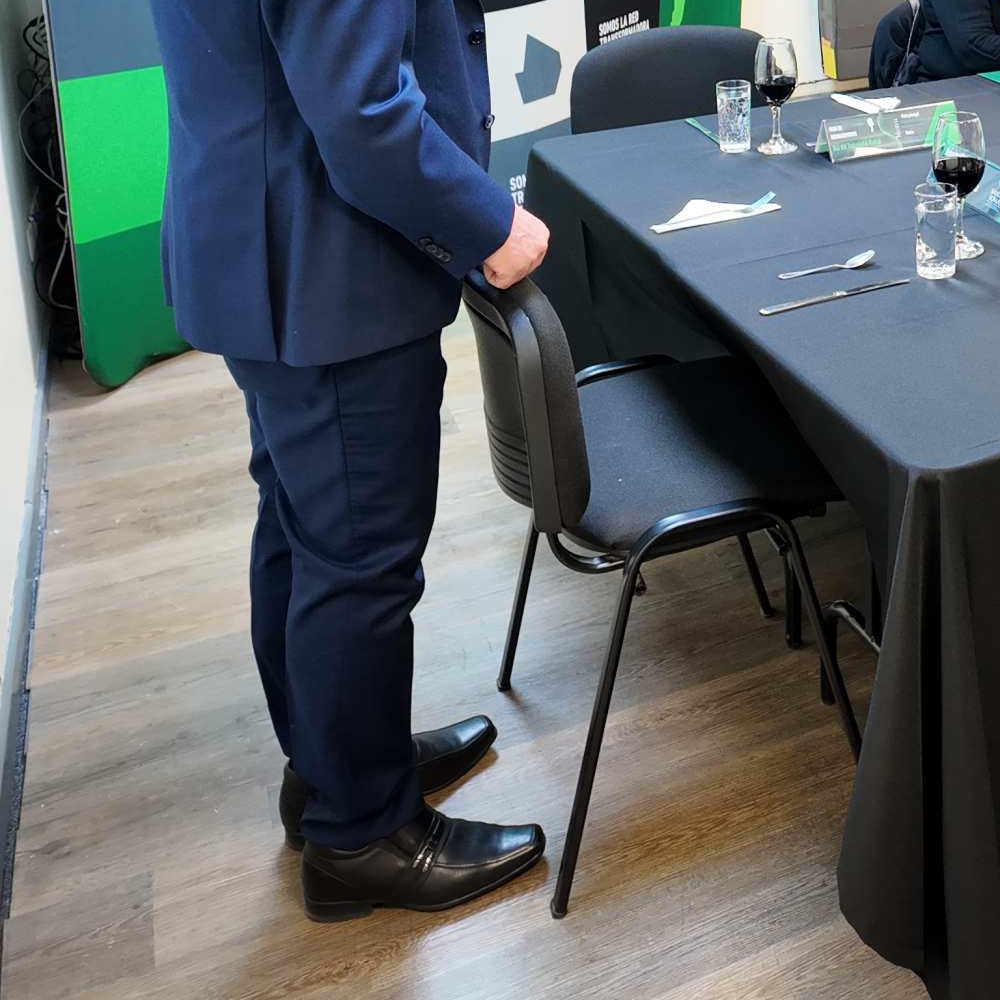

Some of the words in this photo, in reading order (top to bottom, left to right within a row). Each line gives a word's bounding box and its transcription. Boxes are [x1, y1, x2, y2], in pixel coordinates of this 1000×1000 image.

[599, 17, 620, 37] SOMOS
[620, 14, 628, 29] LA
[628, 10, 639, 26] RED
